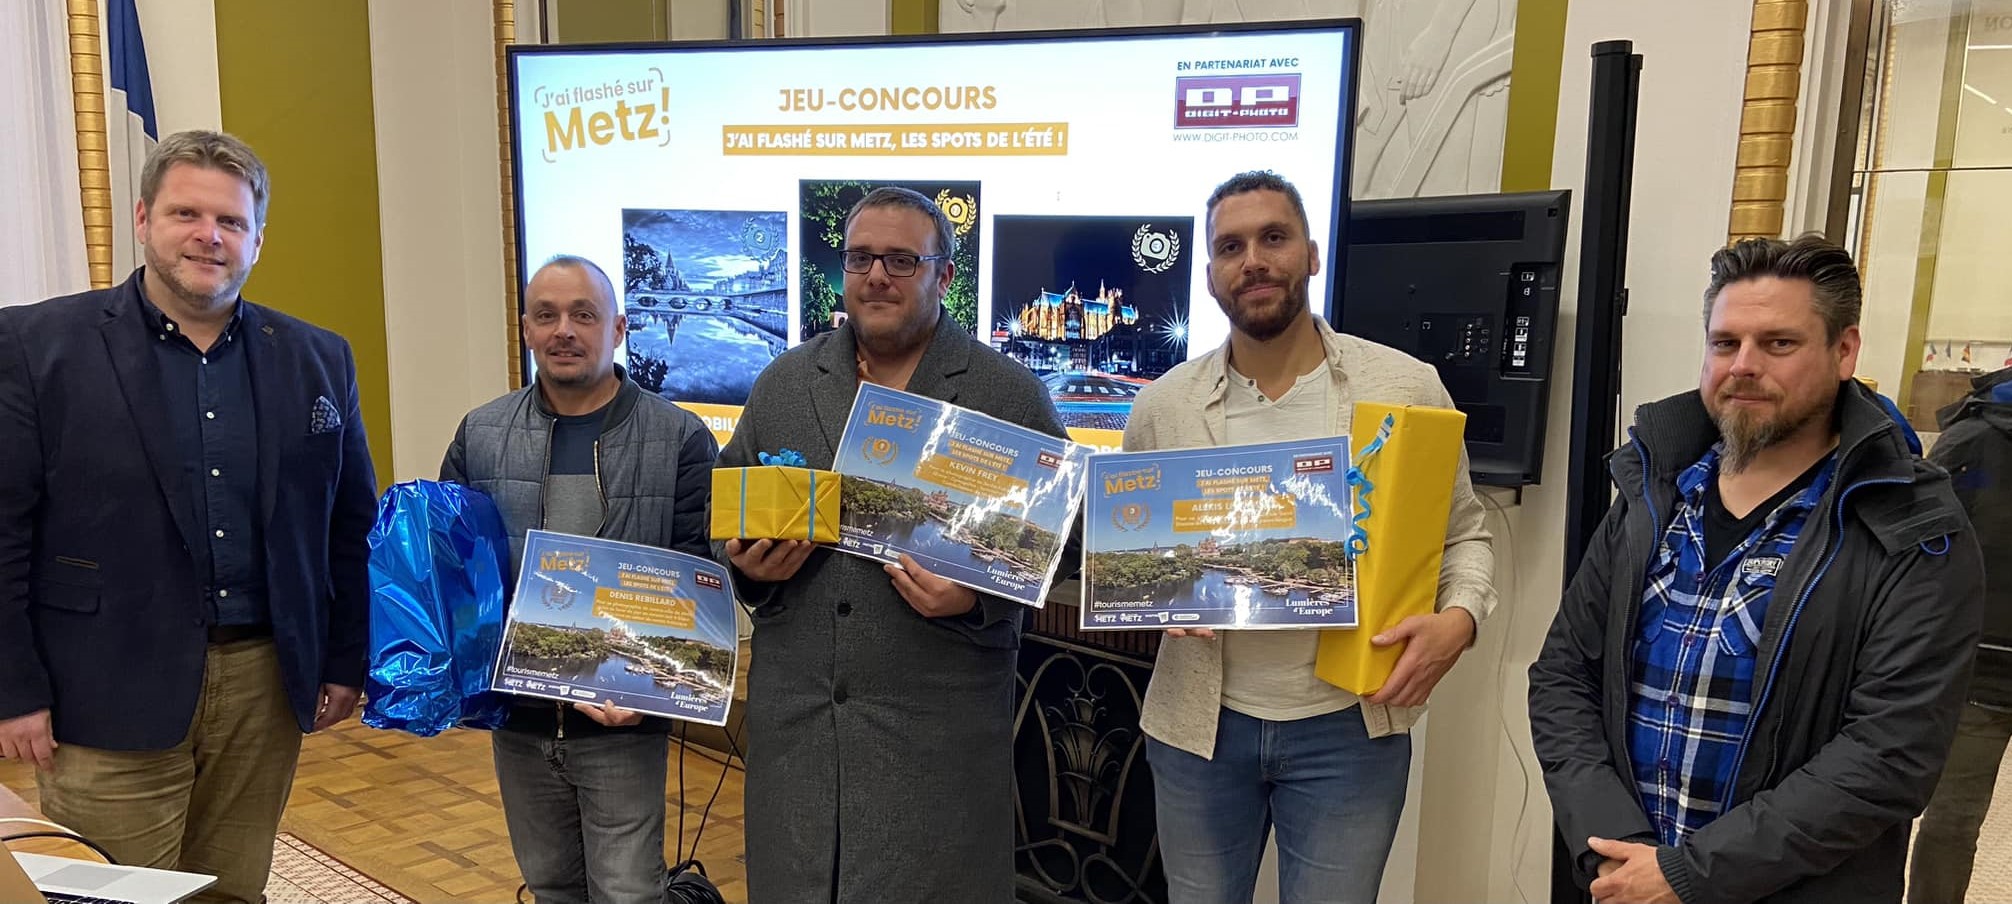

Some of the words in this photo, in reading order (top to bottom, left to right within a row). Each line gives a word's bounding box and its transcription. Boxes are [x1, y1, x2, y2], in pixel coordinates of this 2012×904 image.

[1177, 61, 1191, 71] EN
[1195, 59, 1267, 70] PARTENARIAT
[1269, 57, 1299, 67] AVEC
[542, 89, 570, 108] J'ai
[574, 79, 624, 103] flashé
[628, 78, 654, 95] sur
[778, 86, 998, 112] JEU-CONCOURS
[726, 133, 754, 149] J'AI
[757, 129, 812, 149] FLASHÉ
[816, 132, 846, 148] SUR
[854, 132, 897, 151] METZ,
[901, 131, 928, 148] LES
[932, 131, 982, 148] SPOTS
[987, 131, 1009, 147] DE
[1013, 127, 1054, 147] L'ÉTÉ
[1057, 131, 1064, 147] !
[1173, 132, 1299, 142] WWW.DIGIT-PHOTO.COM
[949, 461, 976, 475] KEVIN
[978, 469, 998, 481] FREY
[1195, 465, 1273, 478] JEU-CONCOURS
[618, 562, 681, 578] JEU-CONCOURS
[987, 565, 1025, 582] Lumières
[609, 591, 634, 601] DENIS
[635, 594, 677, 606] REBILLARD
[1094, 600, 1154, 609] #tourismemetz
[1286, 598, 1330, 607] Lumières
